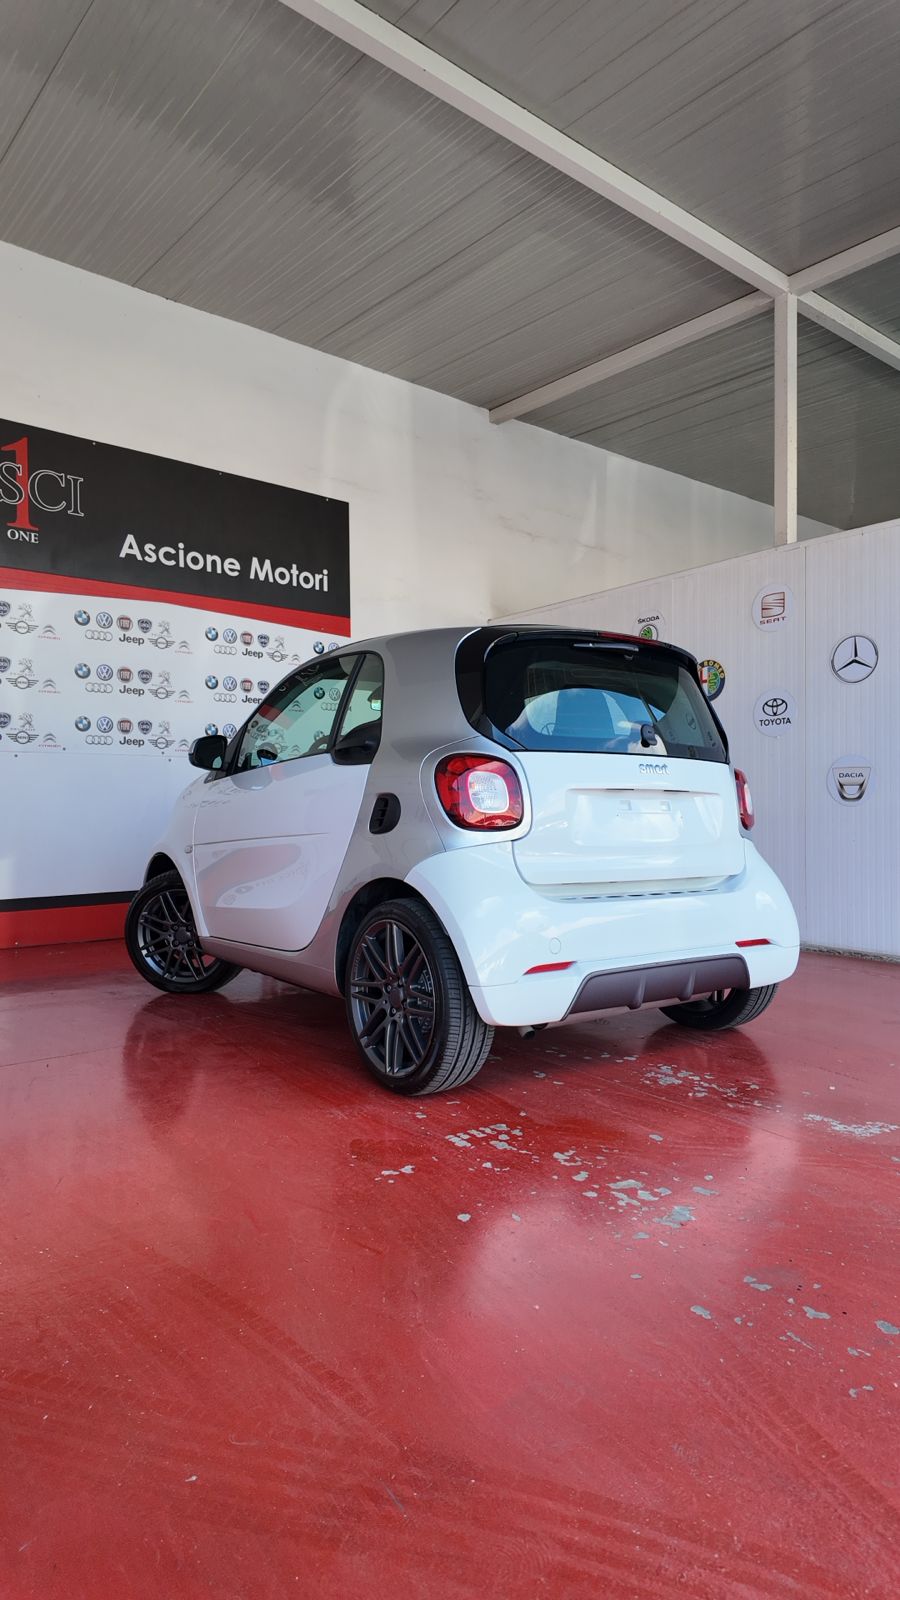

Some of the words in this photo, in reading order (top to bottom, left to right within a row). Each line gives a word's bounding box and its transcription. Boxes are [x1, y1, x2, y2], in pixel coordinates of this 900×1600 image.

[7, 529, 39, 543] ONE
[119, 534, 241, 577] Ascione
[249, 556, 329, 592] Motori
[759, 616, 786, 625] SEAT
[118, 633, 145, 646] Jeep
[241, 648, 264, 659] Jeep
[119, 685, 145, 697] Jeep
[759, 717, 791, 727] TOYOTA
[119, 736, 145, 748] Jeep
[638, 763, 671, 776] smart
